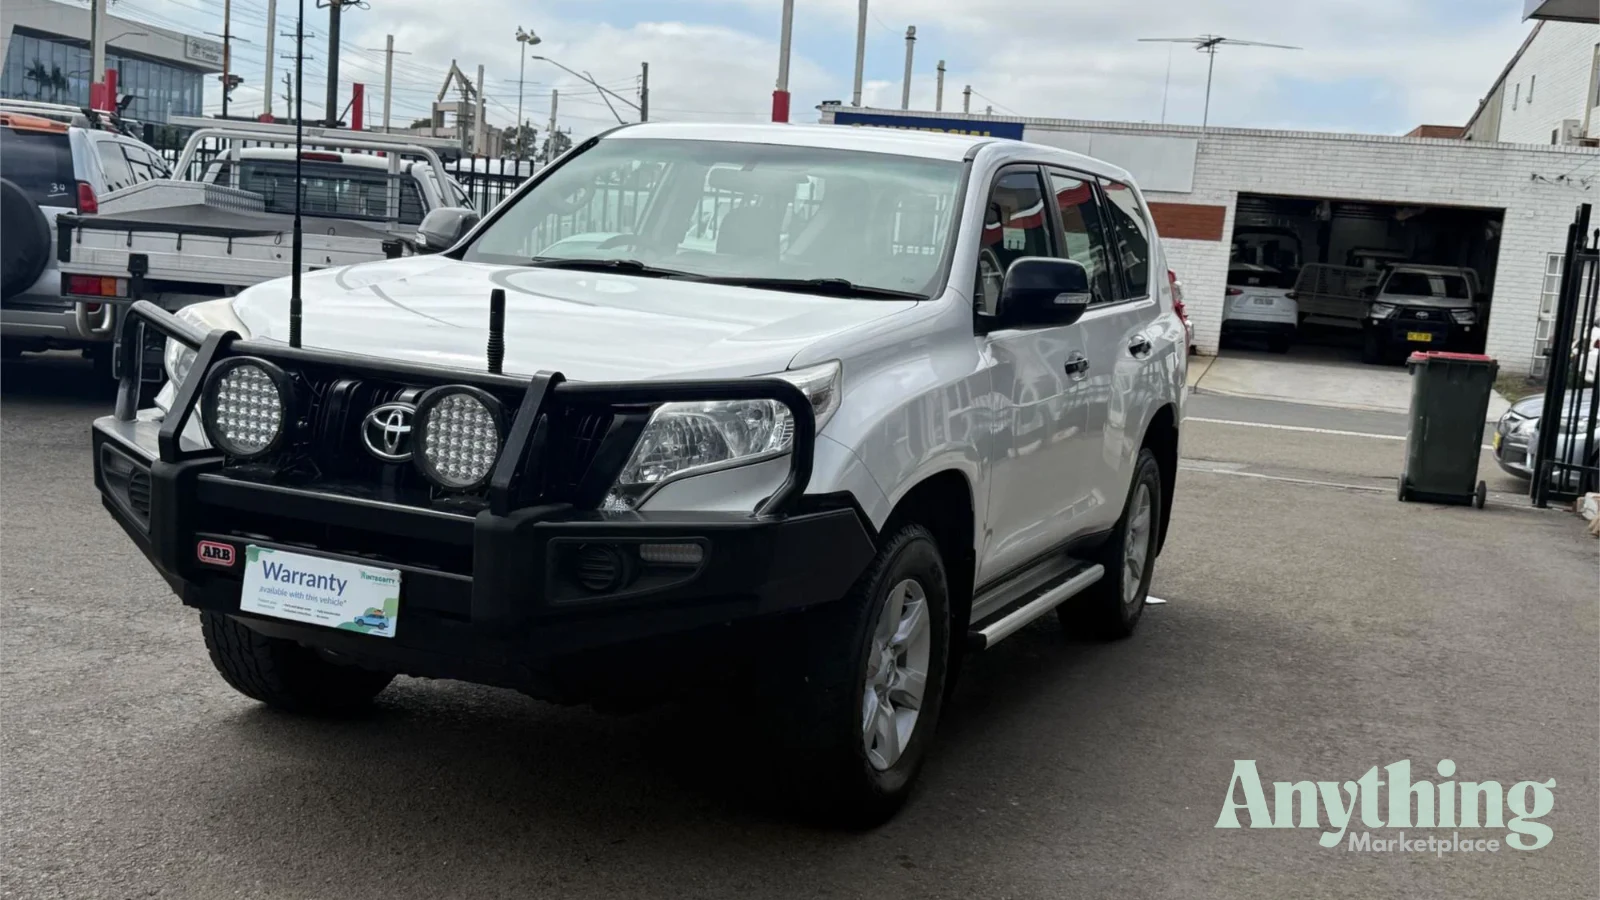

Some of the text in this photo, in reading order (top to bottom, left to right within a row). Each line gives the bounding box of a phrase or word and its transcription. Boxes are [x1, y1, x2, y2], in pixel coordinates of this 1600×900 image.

[202, 545, 231, 561] ARB
[262, 560, 348, 597] Warranty
[259, 585, 288, 597] available
[289, 590, 305, 600] with
[306, 593, 318, 603] this
